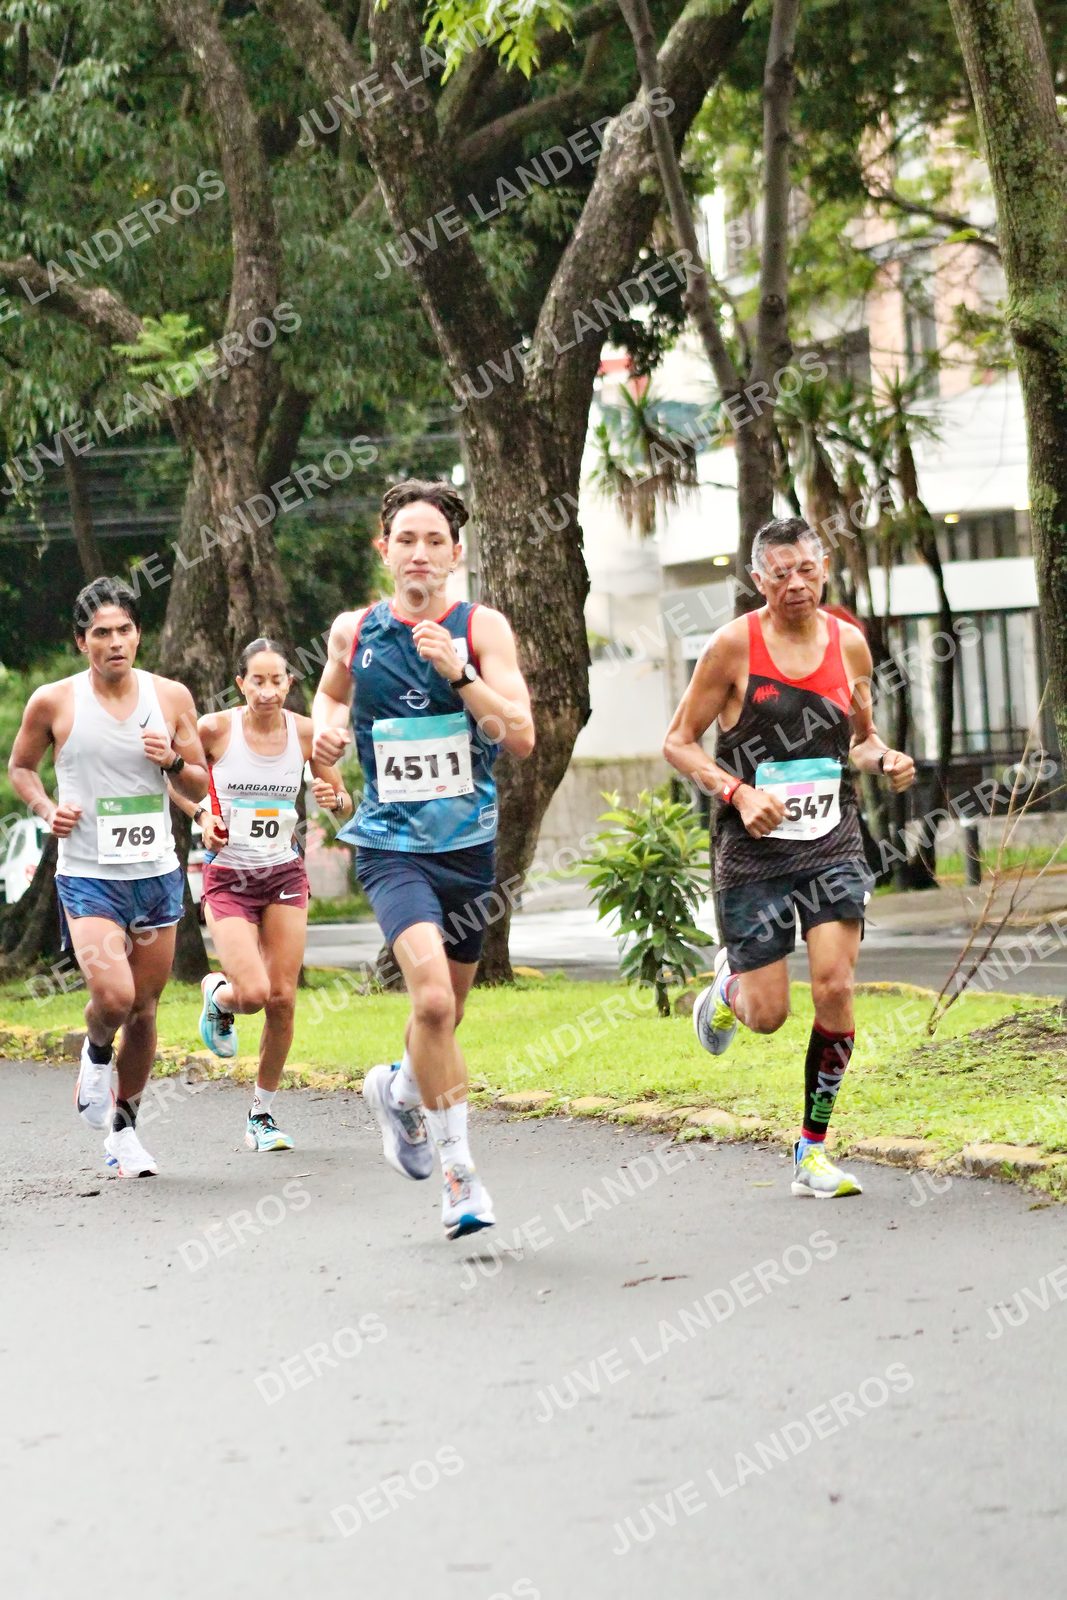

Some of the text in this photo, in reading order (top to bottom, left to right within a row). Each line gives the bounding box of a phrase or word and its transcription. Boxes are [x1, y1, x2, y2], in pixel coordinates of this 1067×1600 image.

[384, 751, 461, 781] 4511
[112, 825, 156, 848] 769
[249, 820, 280, 839] 50
